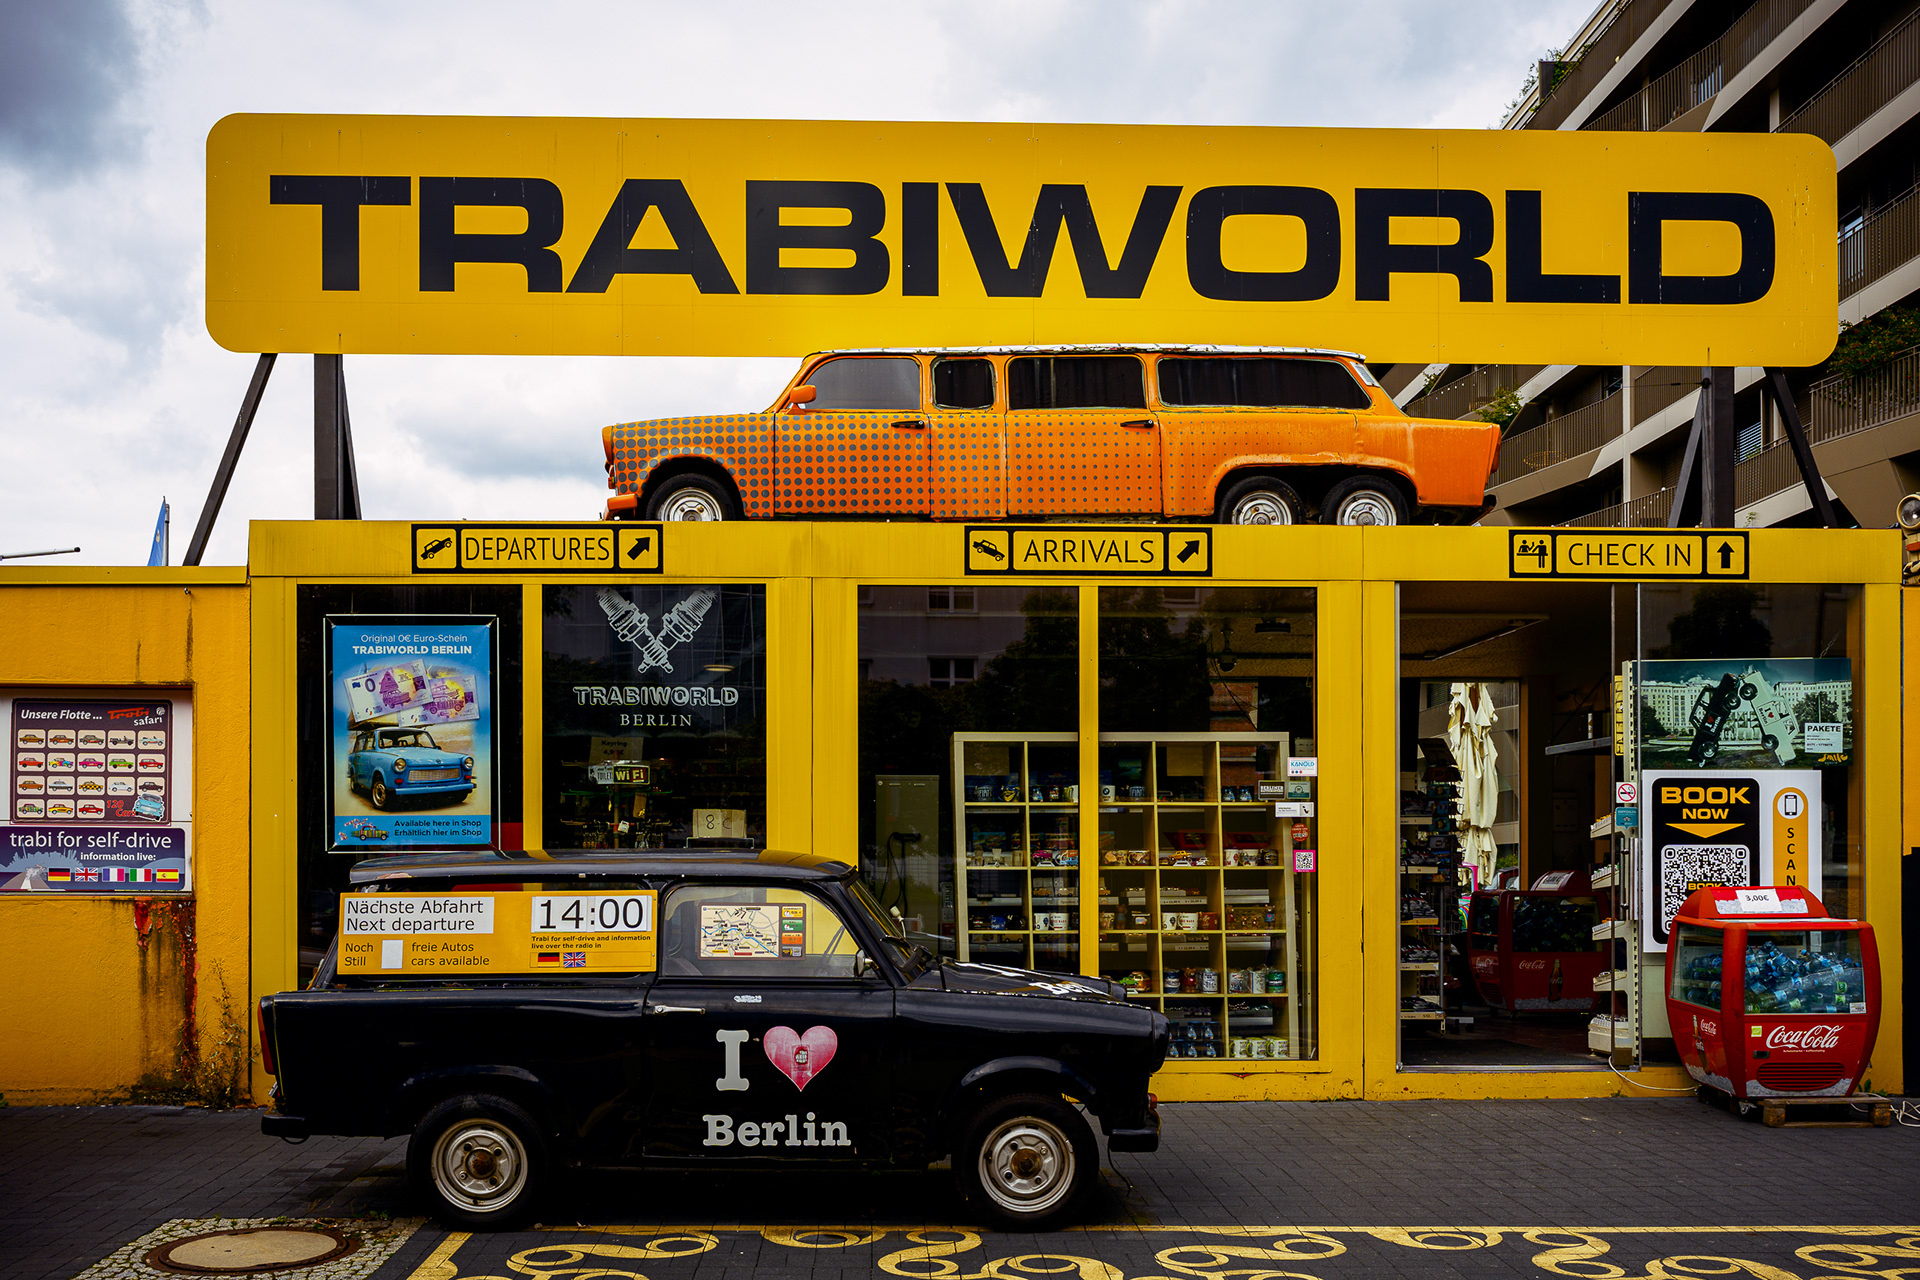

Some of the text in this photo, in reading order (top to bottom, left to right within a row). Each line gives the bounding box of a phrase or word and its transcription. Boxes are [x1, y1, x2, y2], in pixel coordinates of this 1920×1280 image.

[270, 175, 1776, 305] TRABIWORLD
[465, 537, 610, 561] DEPARTURES
[1023, 539, 1155, 563] ARRIVALS
[1568, 543, 1691, 567] CHECK IN
[361, 634, 468, 643] Original 0€ Euro-Schein
[352, 646, 473, 654] TRABIWORLD BERLIN
[572, 686, 740, 706] TRABIWORLD
[21, 710, 58, 719] Unsere
[60, 709, 92, 720] Flotte
[133, 716, 163, 726] safari
[620, 714, 693, 726] BERLIN
[1661, 787, 1750, 804] BOOK
[106, 800, 124, 809] 120
[1682, 808, 1729, 820] NOW
[461, 820, 482, 828] Shop
[394, 828, 432, 836] Erhältlich
[461, 829, 482, 837] Shop
[10, 831, 172, 849] trabi for self-drive
[80, 852, 157, 861] information live:
[1785, 827, 1796, 886] SCAN
[1745, 894, 1769, 902] 3,00€
[347, 900, 484, 914] Nächste Abfahrt
[540, 898, 644, 929] 14:00
[347, 917, 475, 934] Next departure
[345, 942, 474, 952] Noch freie Autos
[345, 955, 490, 966] Still cars available
[716, 1029, 749, 1091] I
[702, 1112, 852, 1146] Berlin
